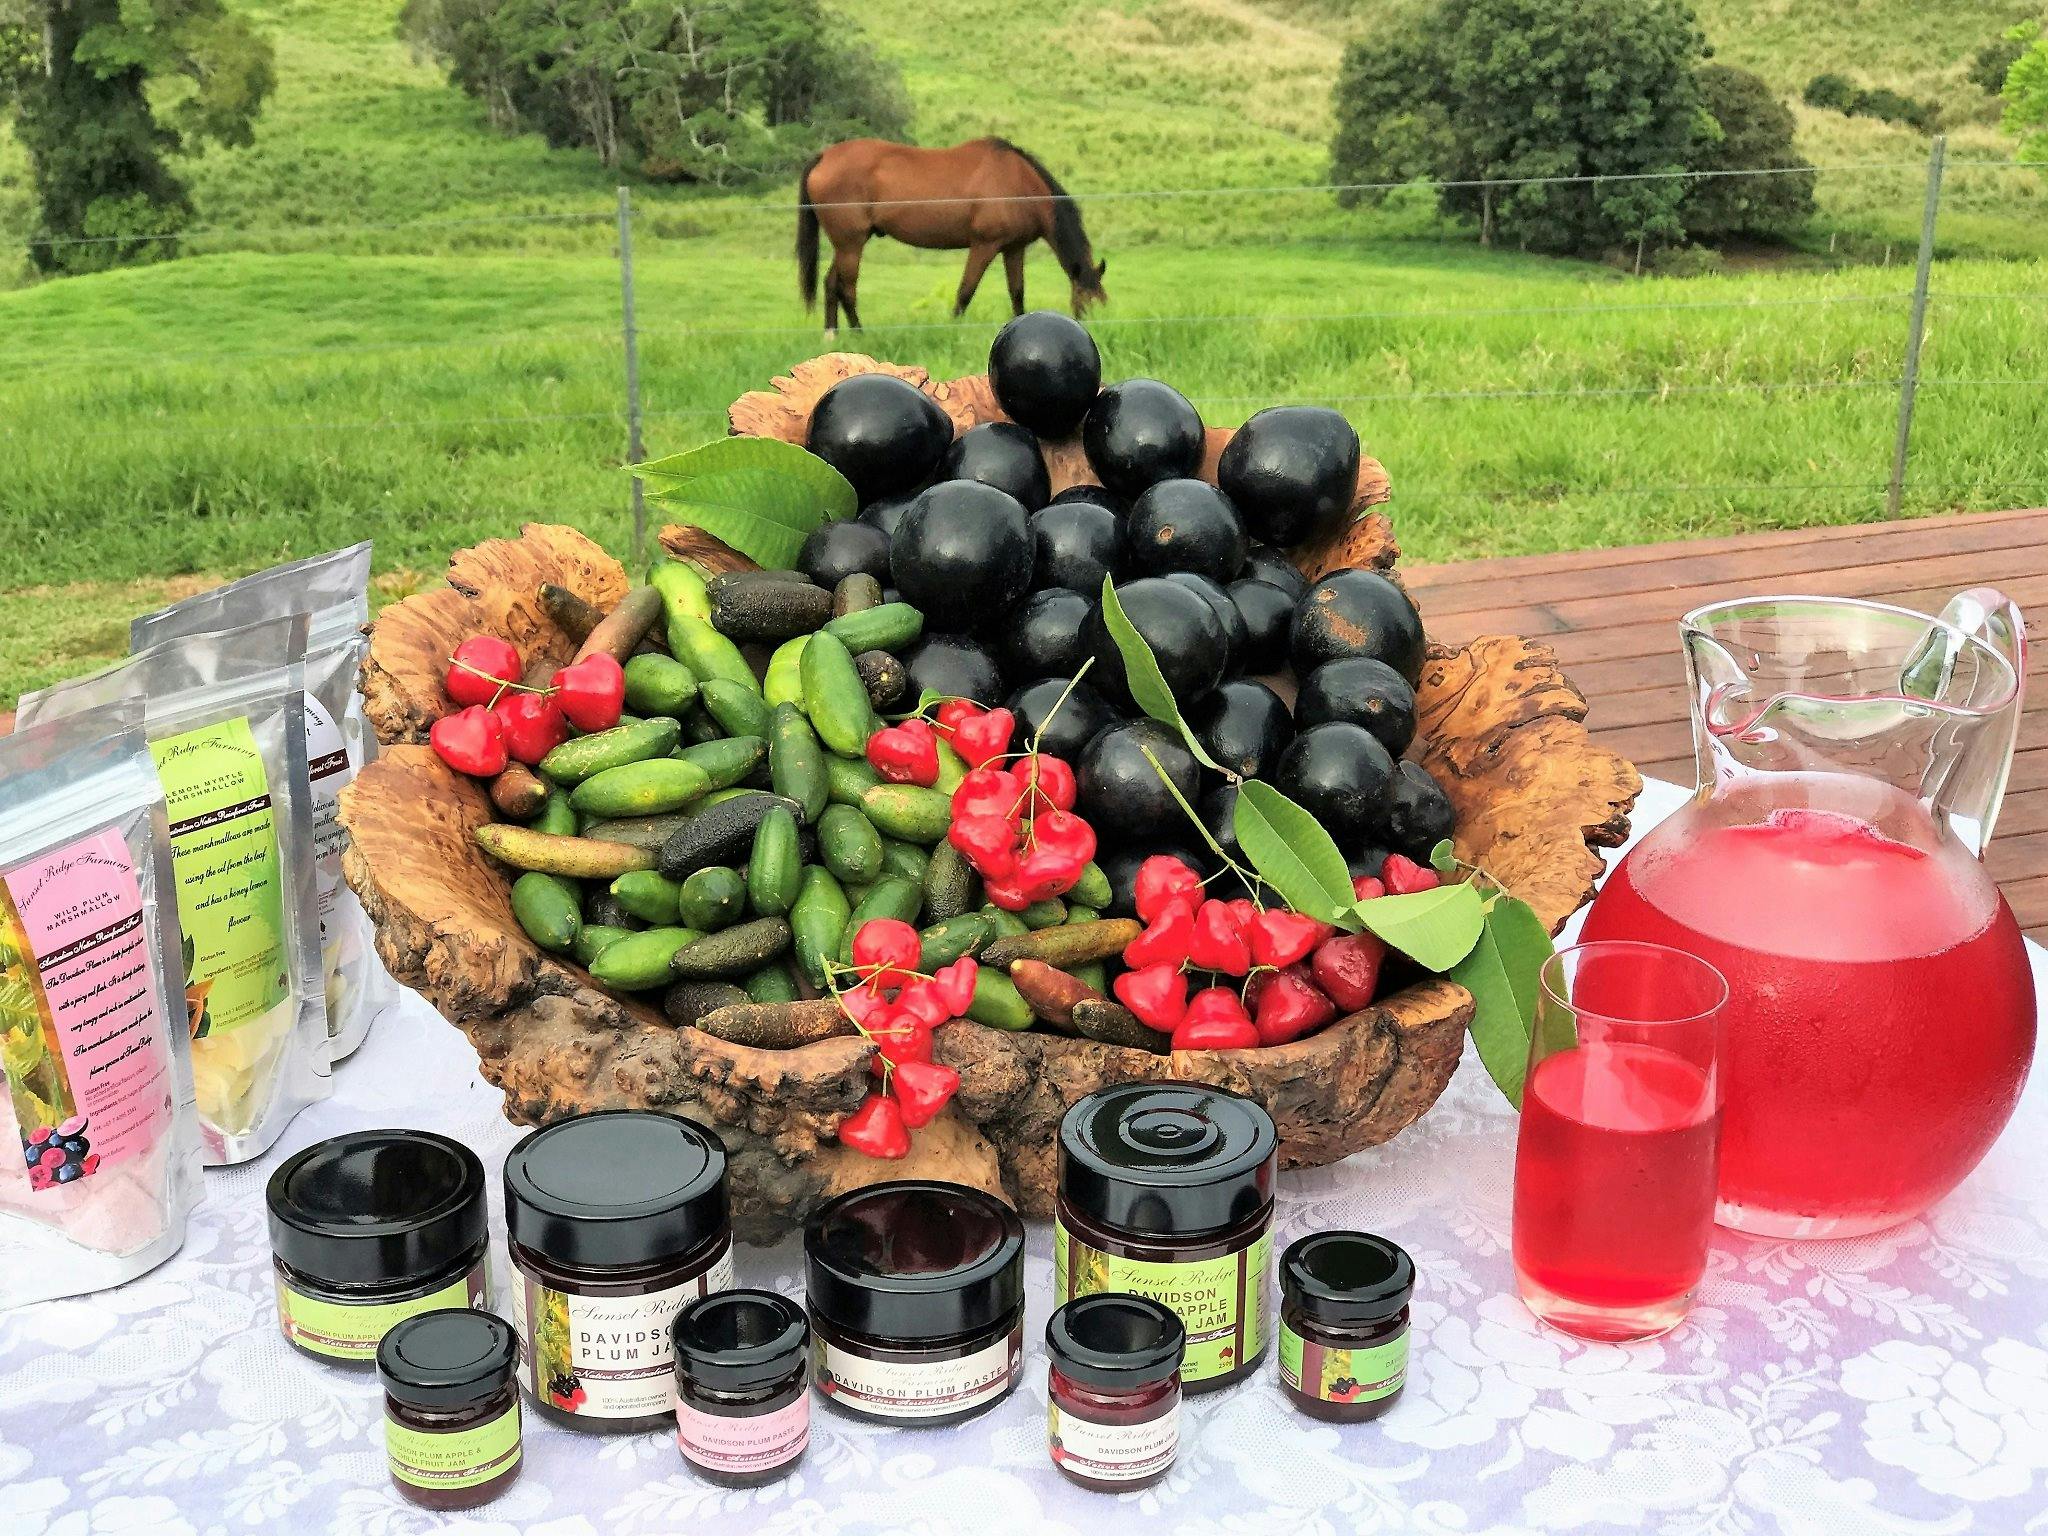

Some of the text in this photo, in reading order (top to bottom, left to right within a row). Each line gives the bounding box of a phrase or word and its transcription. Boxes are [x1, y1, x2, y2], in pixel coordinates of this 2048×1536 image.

[168, 737, 255, 761] Ridge Farming
[324, 755, 343, 770] Fruit
[165, 770, 243, 799] LEMON MYRTLE
[168, 777, 245, 805] MARSHMALLOW
[194, 799, 266, 828] Native Rainforest Fruit
[171, 818, 271, 859] These marshmallows are made
[185, 846, 267, 885] using the oil from the leaf
[18, 852, 131, 918] Sunset Ridge Farming
[195, 895, 210, 911] and
[210, 893, 223, 905] has
[229, 887, 249, 899] honey
[249, 878, 268, 891] lemon
[46, 894, 120, 931] MARSHMALLOW
[53, 891, 109, 920] WILD PLUM
[227, 913, 251, 933] flavour
[38, 949, 74, 970] Australian
[73, 940, 97, 954] Native
[95, 926, 128, 944] Rainforest
[200, 953, 217, 962] Gluten
[45, 978, 60, 990] The
[59, 967, 86, 985] Davidson
[85, 959, 102, 973] Plum
[101, 957, 106, 965] is
[58, 999, 70, 1011] with
[72, 992, 88, 1009] juicy
[87, 987, 96, 998] red
[98, 1007, 109, 1019] and
[108, 1002, 119, 1013] rich
[73, 1045, 88, 1057] The
[84, 1086, 101, 1096] Gluten
[1111, 1266, 1236, 1286] Sunset Ridge
[572, 1304, 641, 1321] Sunset
[1195, 1312, 1227, 1329] JAM
[332, 1332, 355, 1341] PLUM
[1208, 1327, 1236, 1341] Fruit
[319, 1337, 352, 1349] Native
[582, 1347, 639, 1361] PLUM
[572, 1366, 673, 1380] Native Australian
[834, 1372, 906, 1398] DAVIDSON
[915, 1385, 956, 1398] PLUM
[964, 1366, 1003, 1390] PASTE
[615, 1401, 641, 1412] operated
[640, 1398, 667, 1410] company
[618, 1395, 647, 1404] Australian
[647, 1391, 667, 1402] owned
[859, 1388, 980, 1406] Native Australian Fruit
[702, 1435, 745, 1447] DAVIDSON
[747, 1436, 771, 1446] PLUM
[772, 1425, 796, 1441] PASTE
[1067, 1422, 1158, 1441] Sunset Ridge
[419, 1451, 443, 1460] PLUM
[445, 1449, 474, 1459] APPLE
[692, 1446, 781, 1462] Native Australian
[1098, 1447, 1142, 1455] DAVIDSON
[1144, 1440, 1164, 1452] PLUM
[406, 1466, 460, 1479] Australian
[462, 1463, 493, 1476] Fruit
[420, 1459, 445, 1468] FRUIT
[447, 1459, 466, 1467] JAM
